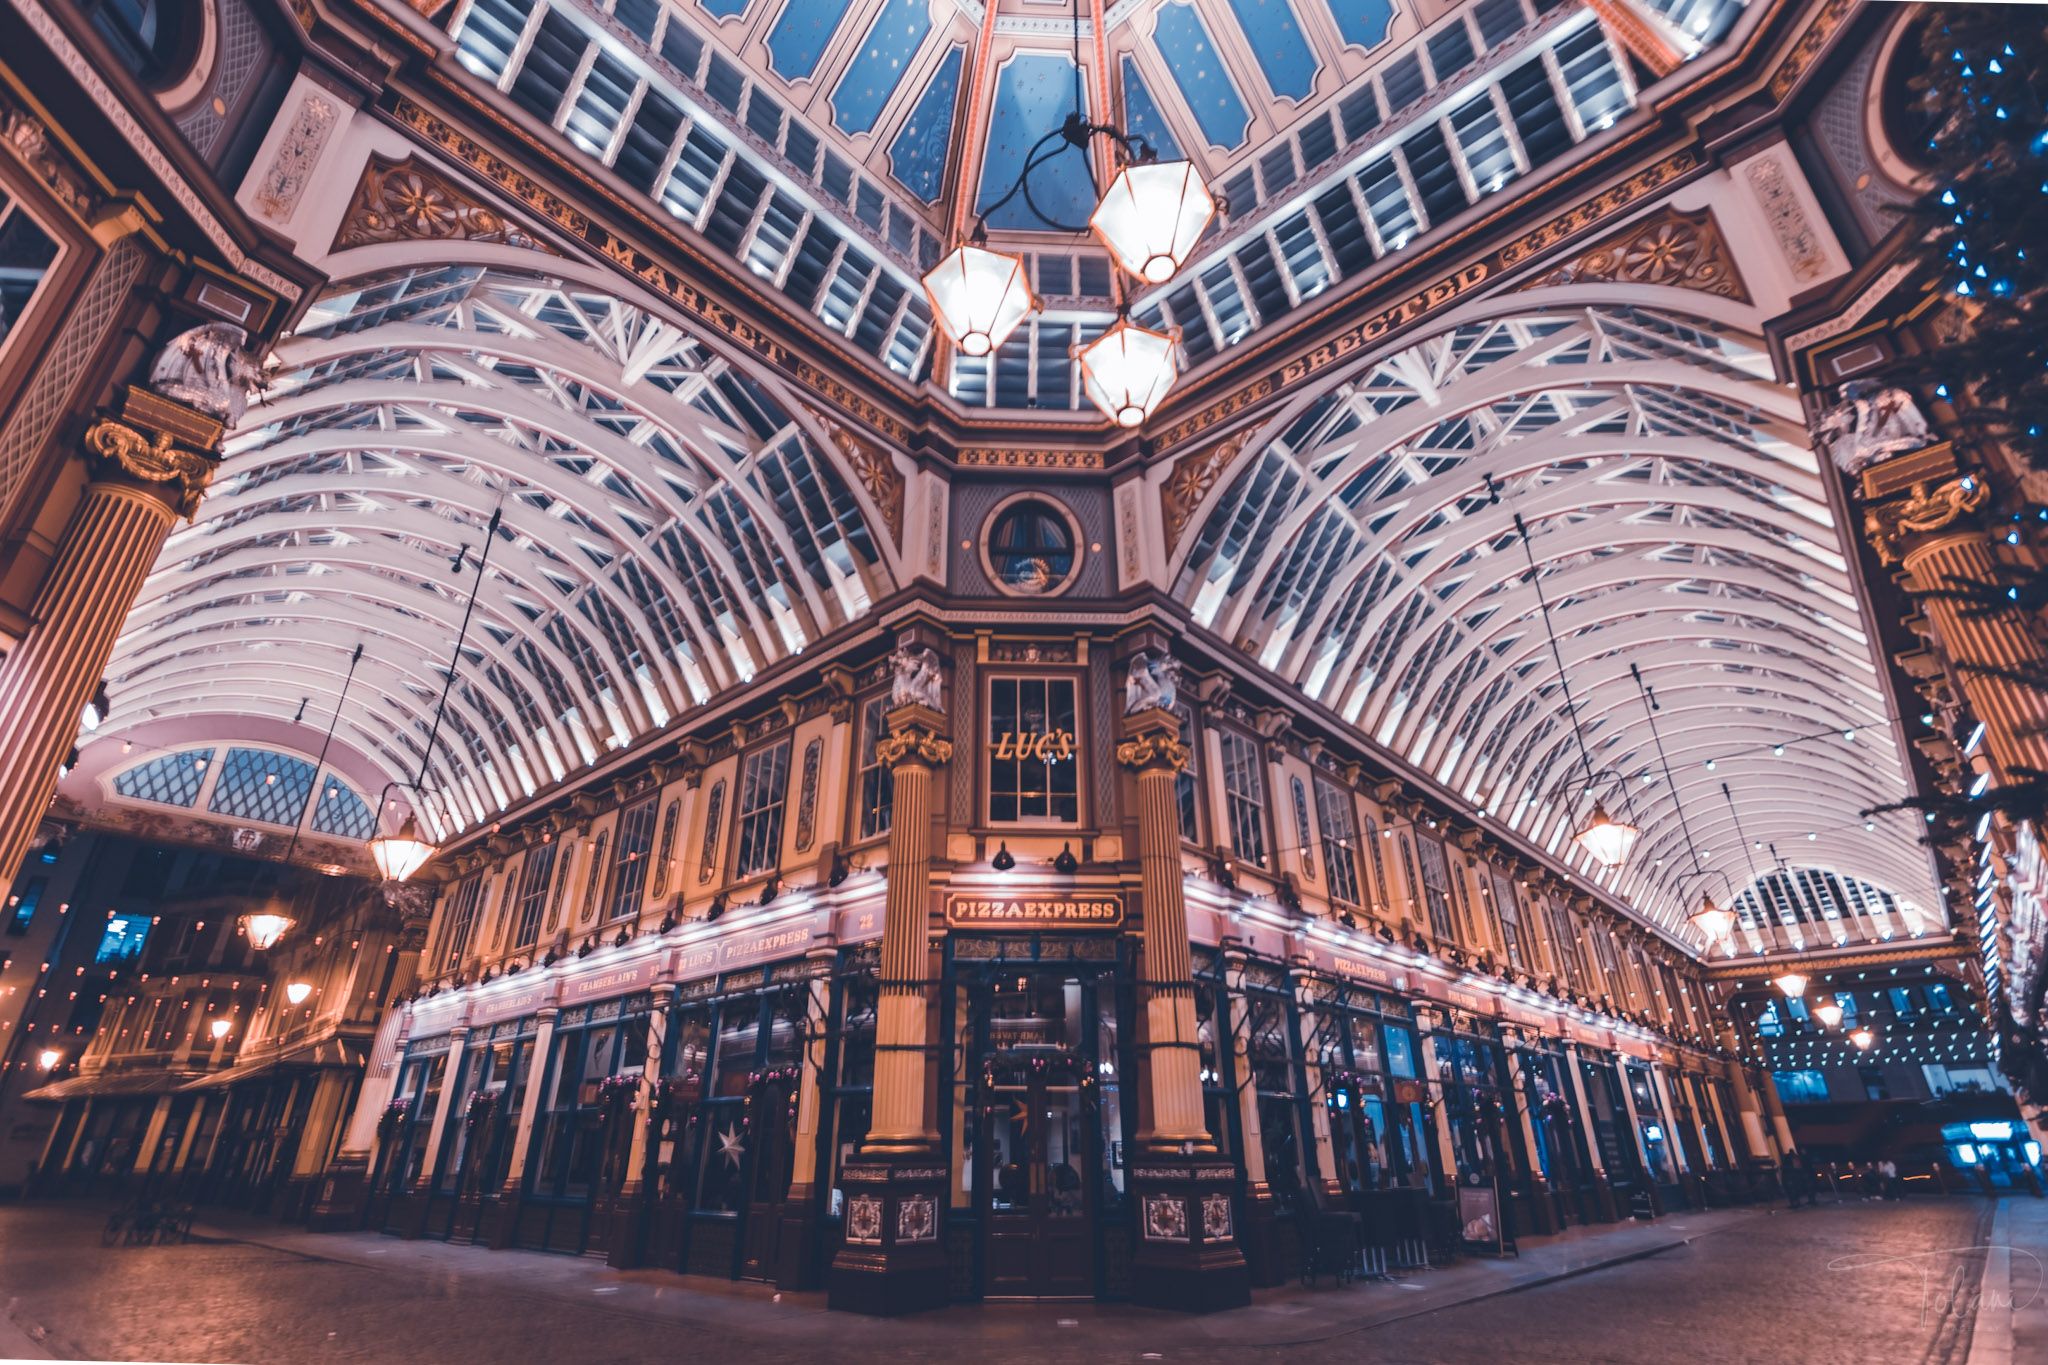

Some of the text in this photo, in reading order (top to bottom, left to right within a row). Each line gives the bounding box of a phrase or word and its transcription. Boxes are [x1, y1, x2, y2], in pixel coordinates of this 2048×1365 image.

[601, 233, 787, 362] MARKET
[1281, 262, 1489, 387] ERECTED
[995, 728, 1073, 761] LUC'S
[956, 902, 1115, 918] PIZZAEXPRESS
[726, 928, 809, 958] PIZZAEXPRESS
